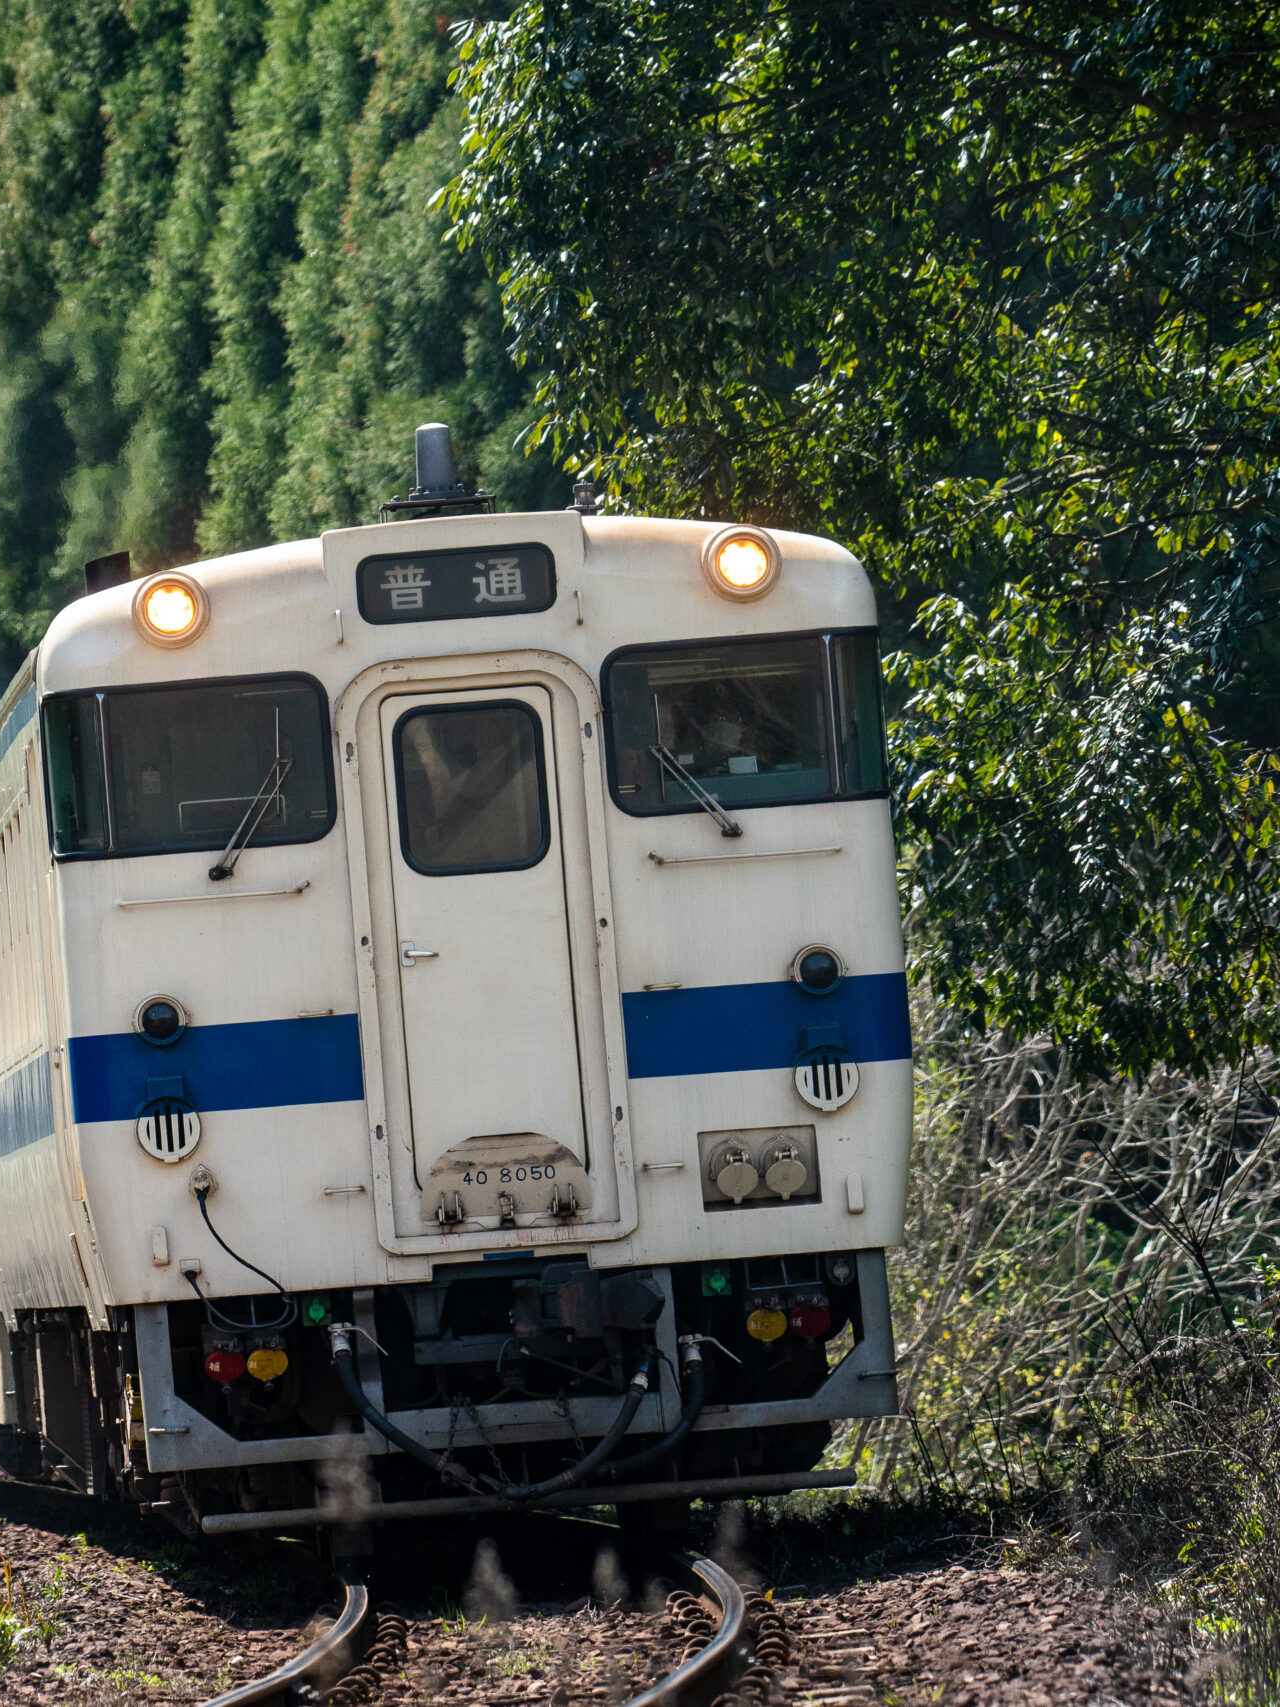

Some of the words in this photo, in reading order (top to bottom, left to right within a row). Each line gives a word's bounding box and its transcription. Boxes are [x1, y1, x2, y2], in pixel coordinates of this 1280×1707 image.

[380, 557, 526, 610] 普通
[463, 1171, 488, 1185] 40
[500, 1164, 556, 1183] 8050
